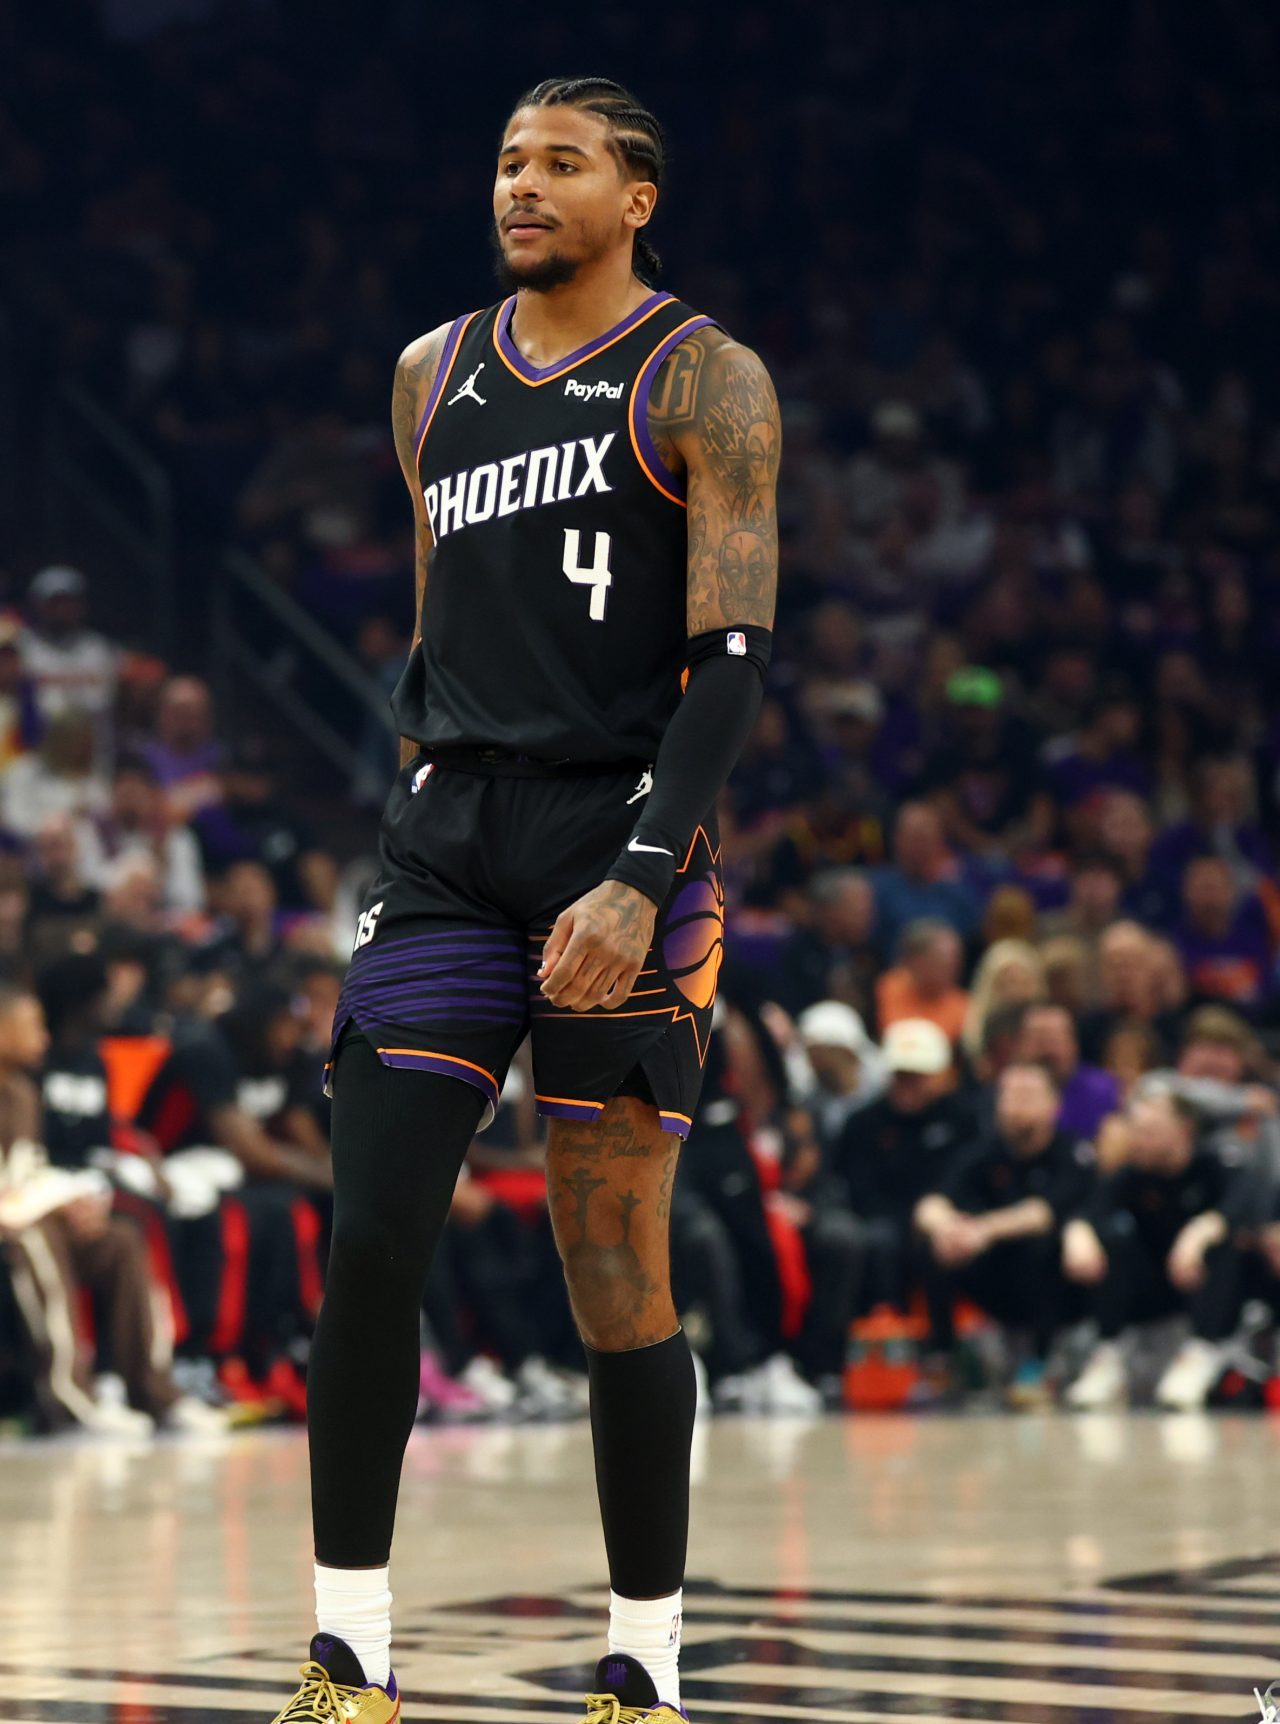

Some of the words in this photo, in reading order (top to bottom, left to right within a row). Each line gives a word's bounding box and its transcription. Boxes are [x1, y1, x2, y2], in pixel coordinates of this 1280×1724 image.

[564, 379, 625, 401] PayPal
[423, 431, 619, 547] PHOENIX
[561, 527, 614, 621] 4
